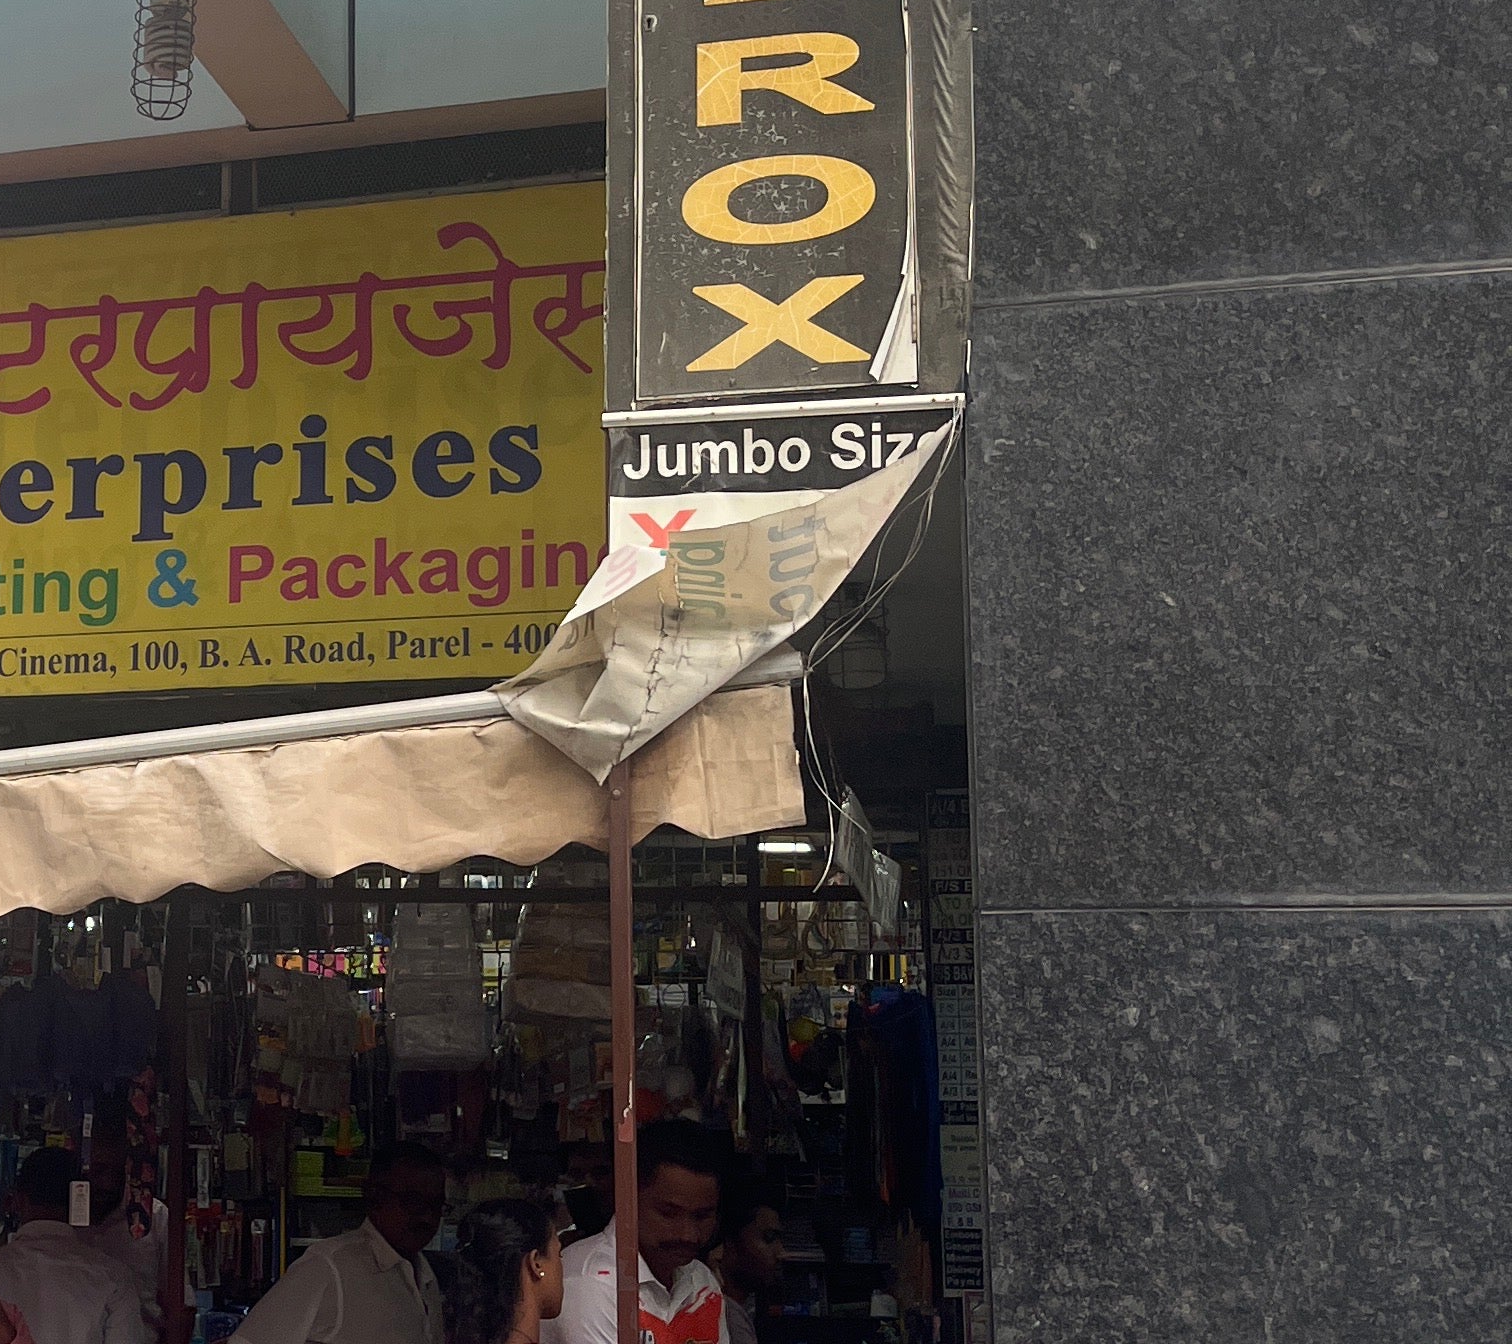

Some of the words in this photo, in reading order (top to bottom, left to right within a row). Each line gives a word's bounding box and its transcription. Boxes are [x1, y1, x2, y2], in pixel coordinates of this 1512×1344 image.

[622, 428, 811, 481] Jumbo
[146, 548, 199, 609] &
[228, 529, 610, 607] Packagin
[128, 641, 189, 676] 100,
[199, 637, 231, 669] B.
[238, 635, 271, 667] A.
[283, 630, 376, 670] Road,
[386, 625, 471, 662] Parel
